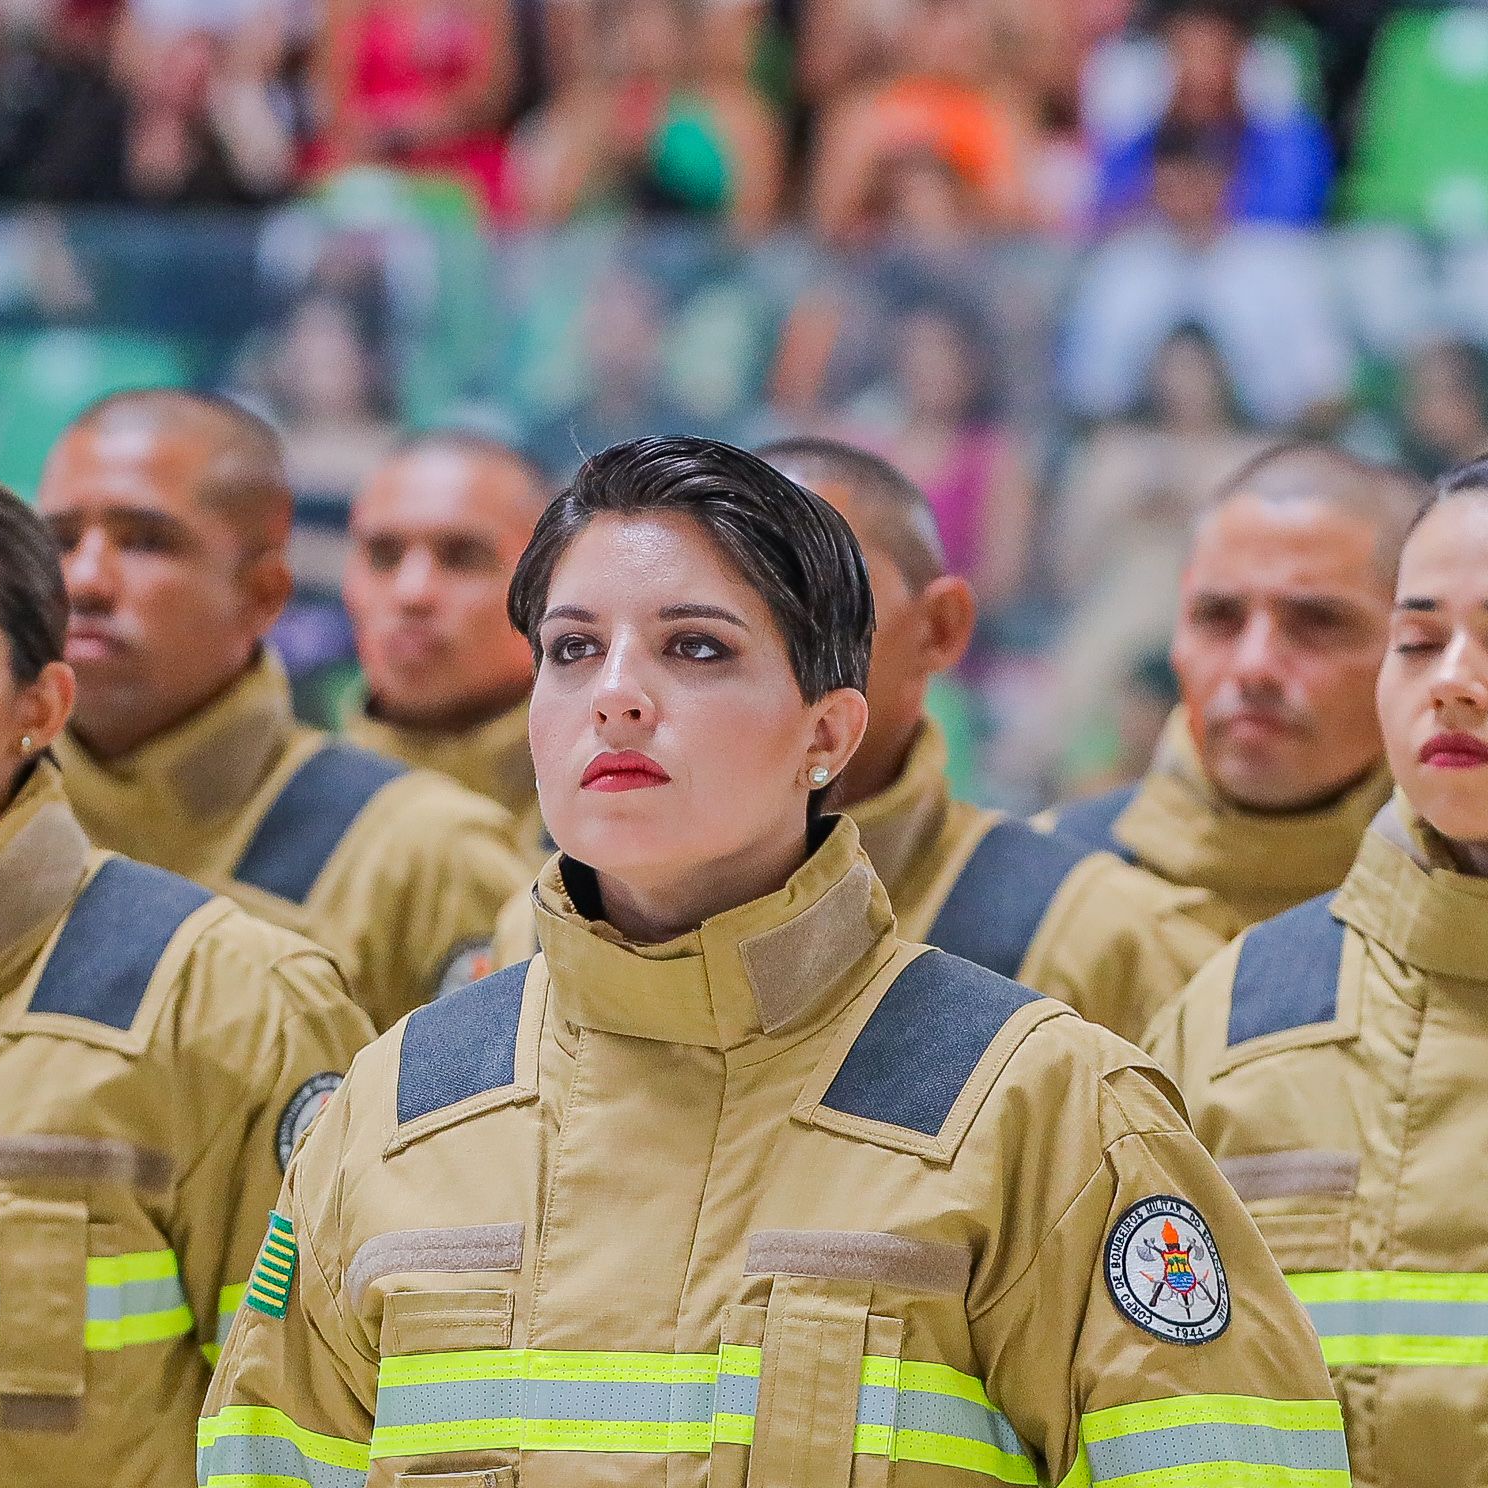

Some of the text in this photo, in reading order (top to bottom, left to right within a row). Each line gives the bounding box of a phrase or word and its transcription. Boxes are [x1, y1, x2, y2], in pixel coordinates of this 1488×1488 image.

[1144, 1201, 1182, 1215] MILITAR
[1189, 1213, 1201, 1228] DO
[1110, 1210, 1143, 1269] BOMBEIROS
[1112, 1275, 1124, 1290] DE
[1120, 1293, 1153, 1325] CORPO
